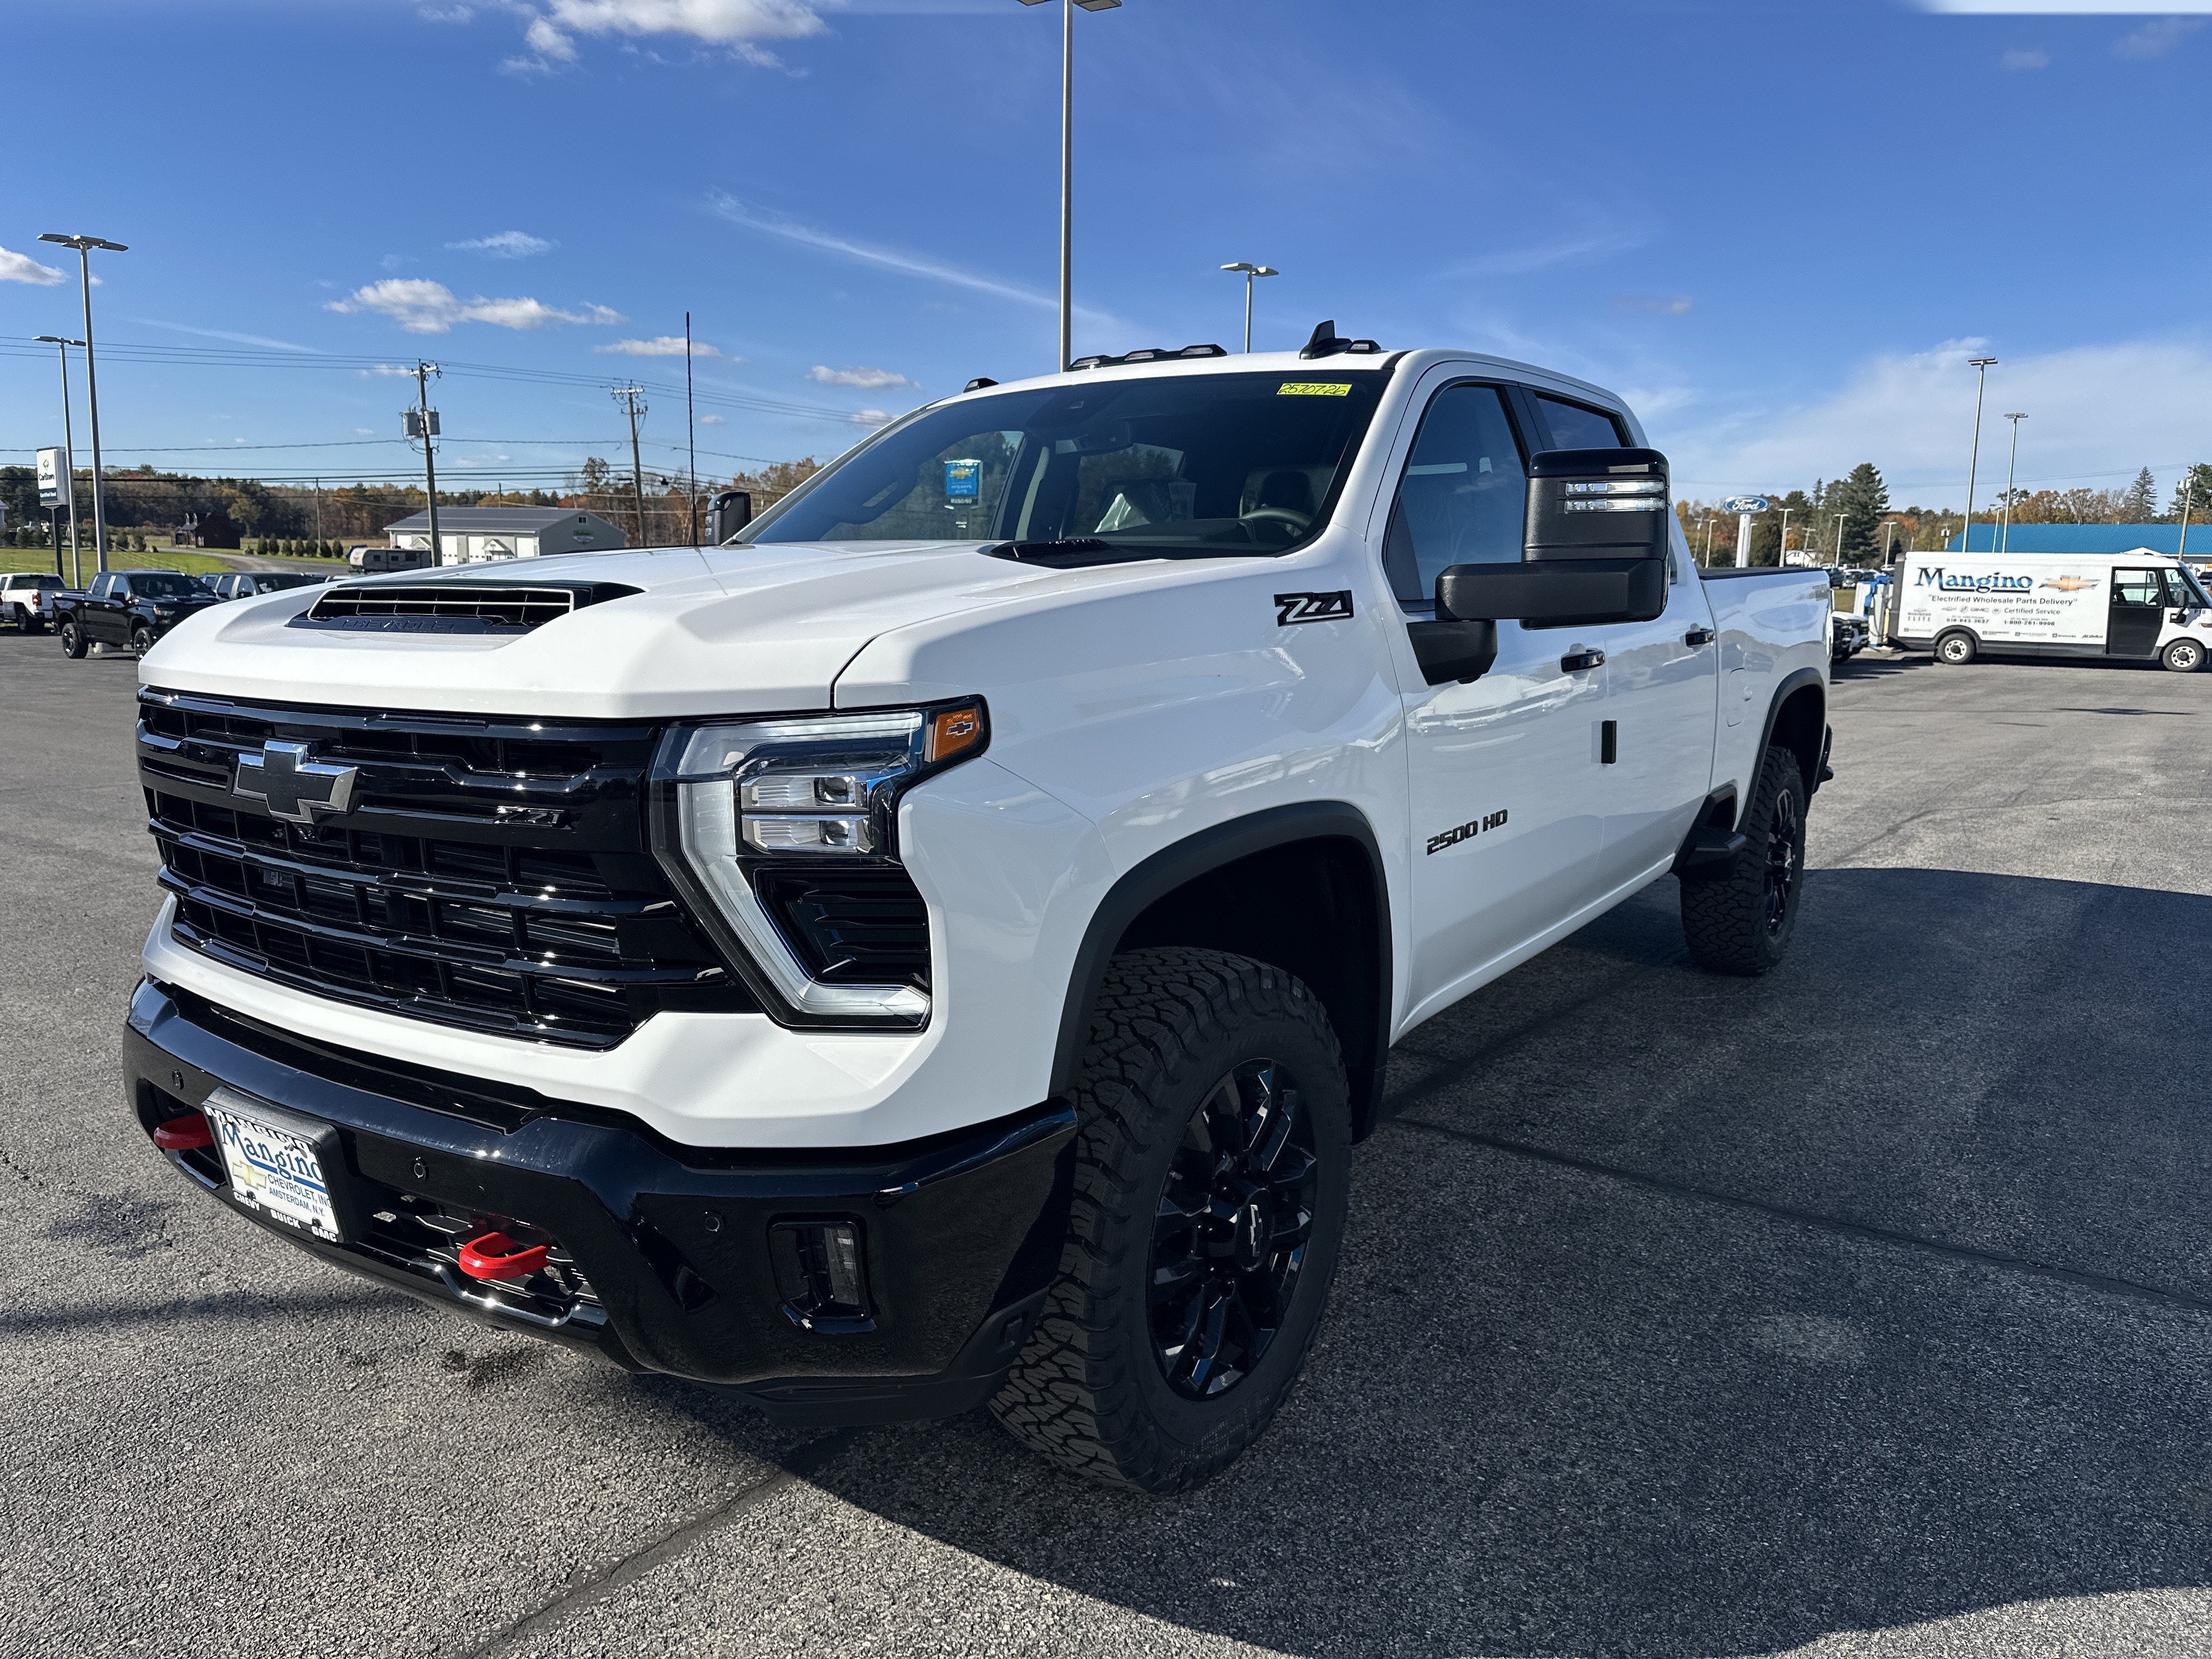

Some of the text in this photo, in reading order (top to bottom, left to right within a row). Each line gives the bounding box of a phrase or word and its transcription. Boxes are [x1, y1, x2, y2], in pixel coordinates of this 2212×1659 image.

[1731, 498, 1760, 510] Ford
[1914, 567, 2033, 594] Mangino
[1273, 589, 1354, 627] Z71
[342, 618, 455, 630] CHEVROLET
[1426, 809, 1508, 855] 2500 HD
[222, 1123, 325, 1182] Mangino
[233, 1191, 260, 1211] CHEVY
[268, 1173, 318, 1204] CHEVROLET,
[269, 1187, 312, 1213] AMSTERDAM,
[270, 1209, 301, 1229] BUICK
[311, 1226, 337, 1243] GMC
